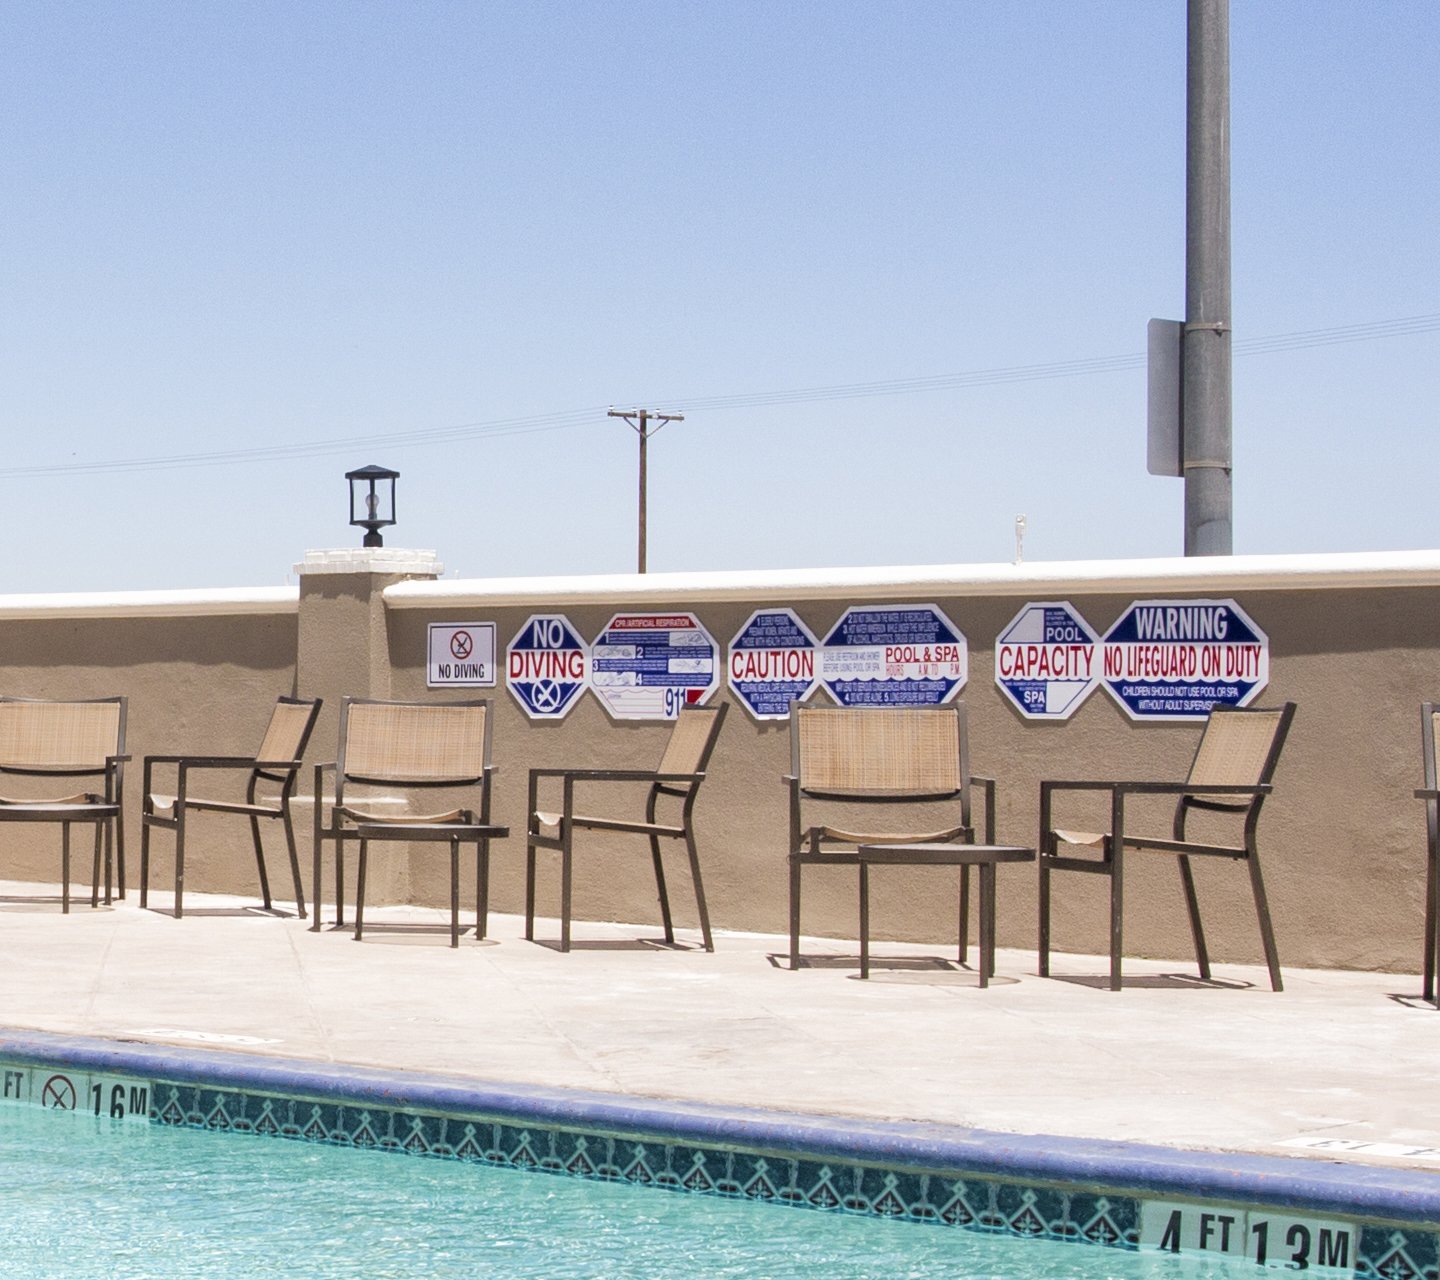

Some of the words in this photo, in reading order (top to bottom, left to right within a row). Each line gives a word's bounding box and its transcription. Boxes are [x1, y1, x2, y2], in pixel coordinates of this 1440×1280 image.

[533, 620, 564, 648] NO
[1046, 627, 1082, 641] POOL
[1135, 607, 1228, 640] WARNING
[637, 647, 644, 658] 2
[886, 646, 920, 662] POOL
[924, 646, 931, 662] &
[935, 646, 959, 662] SPA
[1000, 646, 1094, 676] CAPACITY
[1104, 645, 1122, 677] NO
[1127, 645, 1196, 677] LIFEGUARD
[1202, 645, 1220, 677] ON
[1226, 645, 1262, 677] DUTY
[439, 664, 451, 678] NO
[454, 664, 484, 678] DIVING
[510, 651, 584, 678] DIVING
[593, 660, 598, 671] 3
[732, 650, 813, 678] CAUTION
[636, 675, 642, 685] 4
[666, 688, 686, 716] 911
[1024, 691, 1045, 703] SPA
[1122, 686, 1150, 697] CHILDREN
[1151, 686, 1174, 697] SHOULD
[1175, 686, 1187, 697] NOT
[1188, 686, 1199, 697] USE
[1200, 686, 1216, 697] POOL
[1217, 686, 1226, 697] OR
[1227, 686, 1239, 697] SPA
[1138, 699, 1164, 710] WITHOUT
[1165, 699, 1183, 710] ADULT
[4, 1071, 24, 1099] FT
[1200, 1213, 1235, 1252] FT
